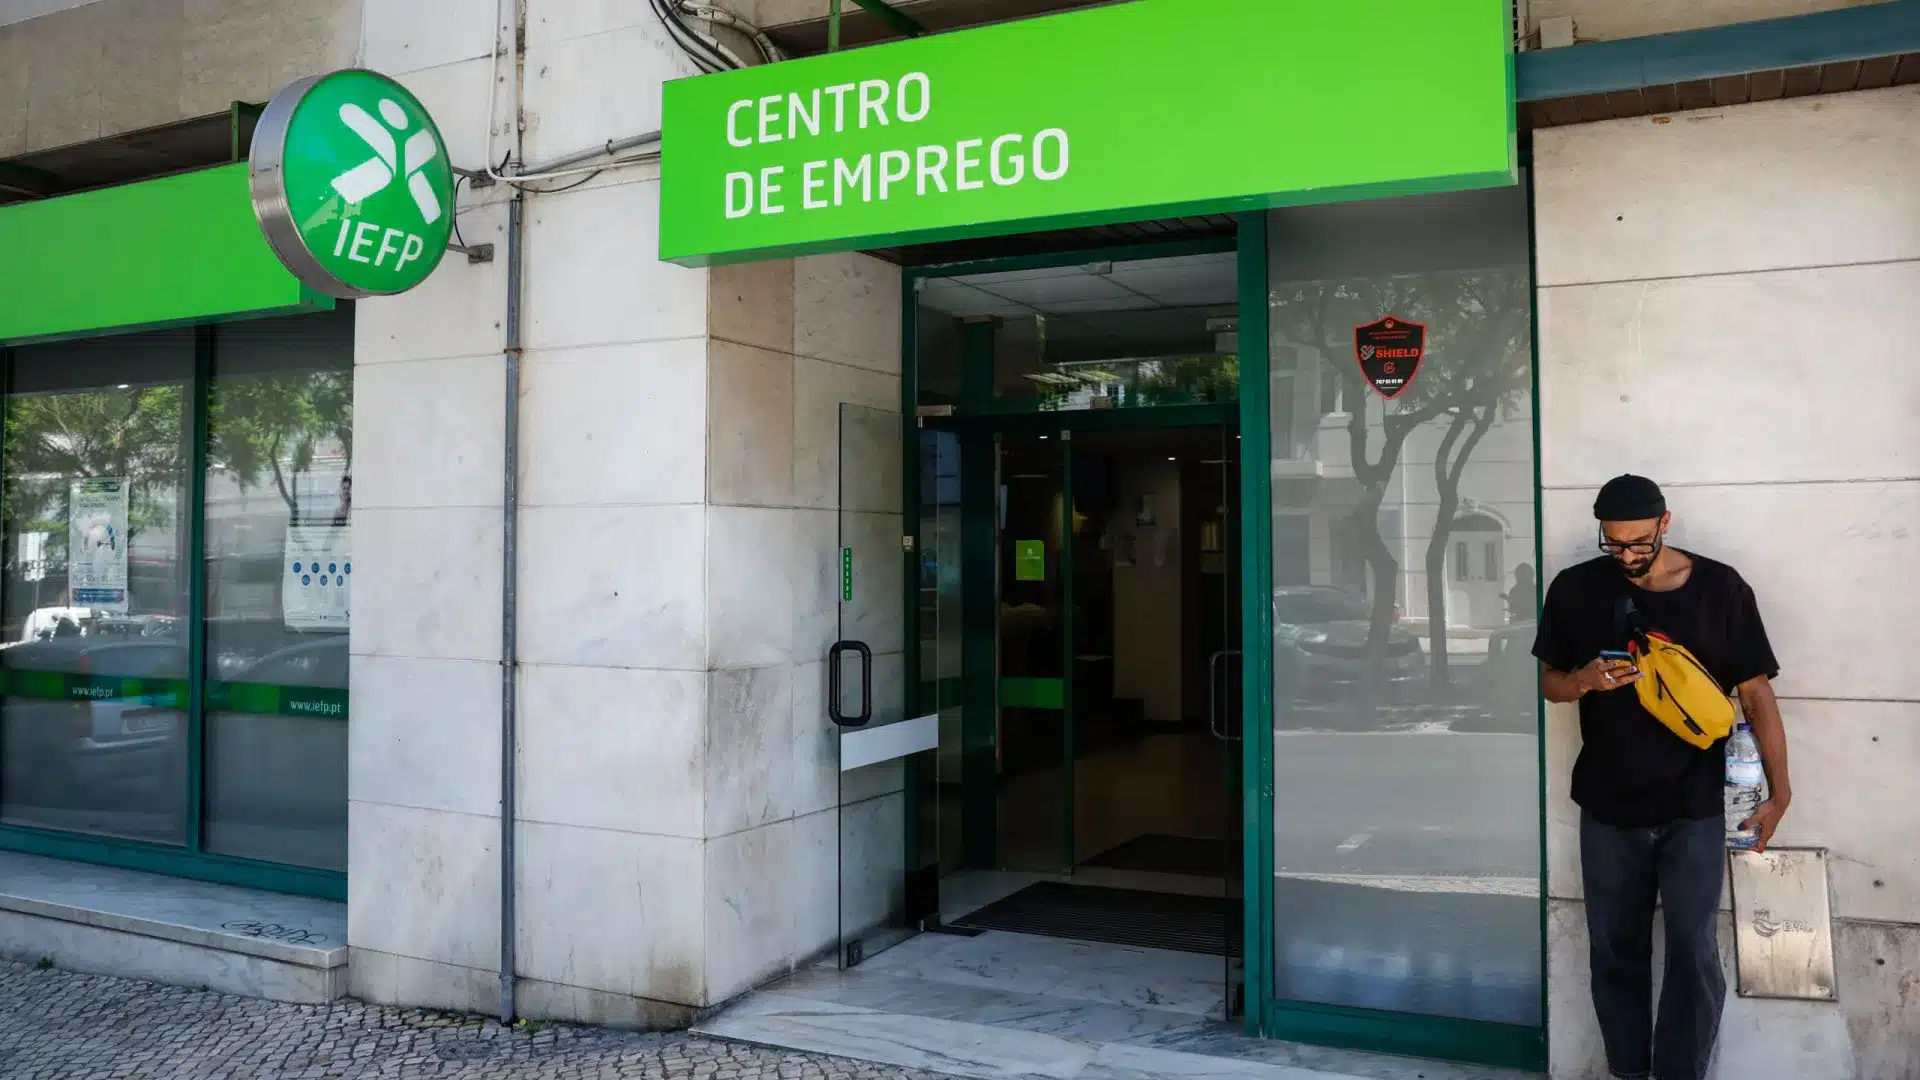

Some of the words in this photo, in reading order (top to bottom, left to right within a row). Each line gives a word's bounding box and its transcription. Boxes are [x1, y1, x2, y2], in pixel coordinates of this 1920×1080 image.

[726, 71, 931, 148] CENTRO
[724, 165, 785, 220] DE
[802, 127, 1070, 210] EMPREGO
[333, 218, 424, 273] IEFP
[1376, 348, 1419, 358] SHIELD
[72, 686, 113, 699] www.iefp.pt
[290, 700, 342, 716] www.iefp.pt
